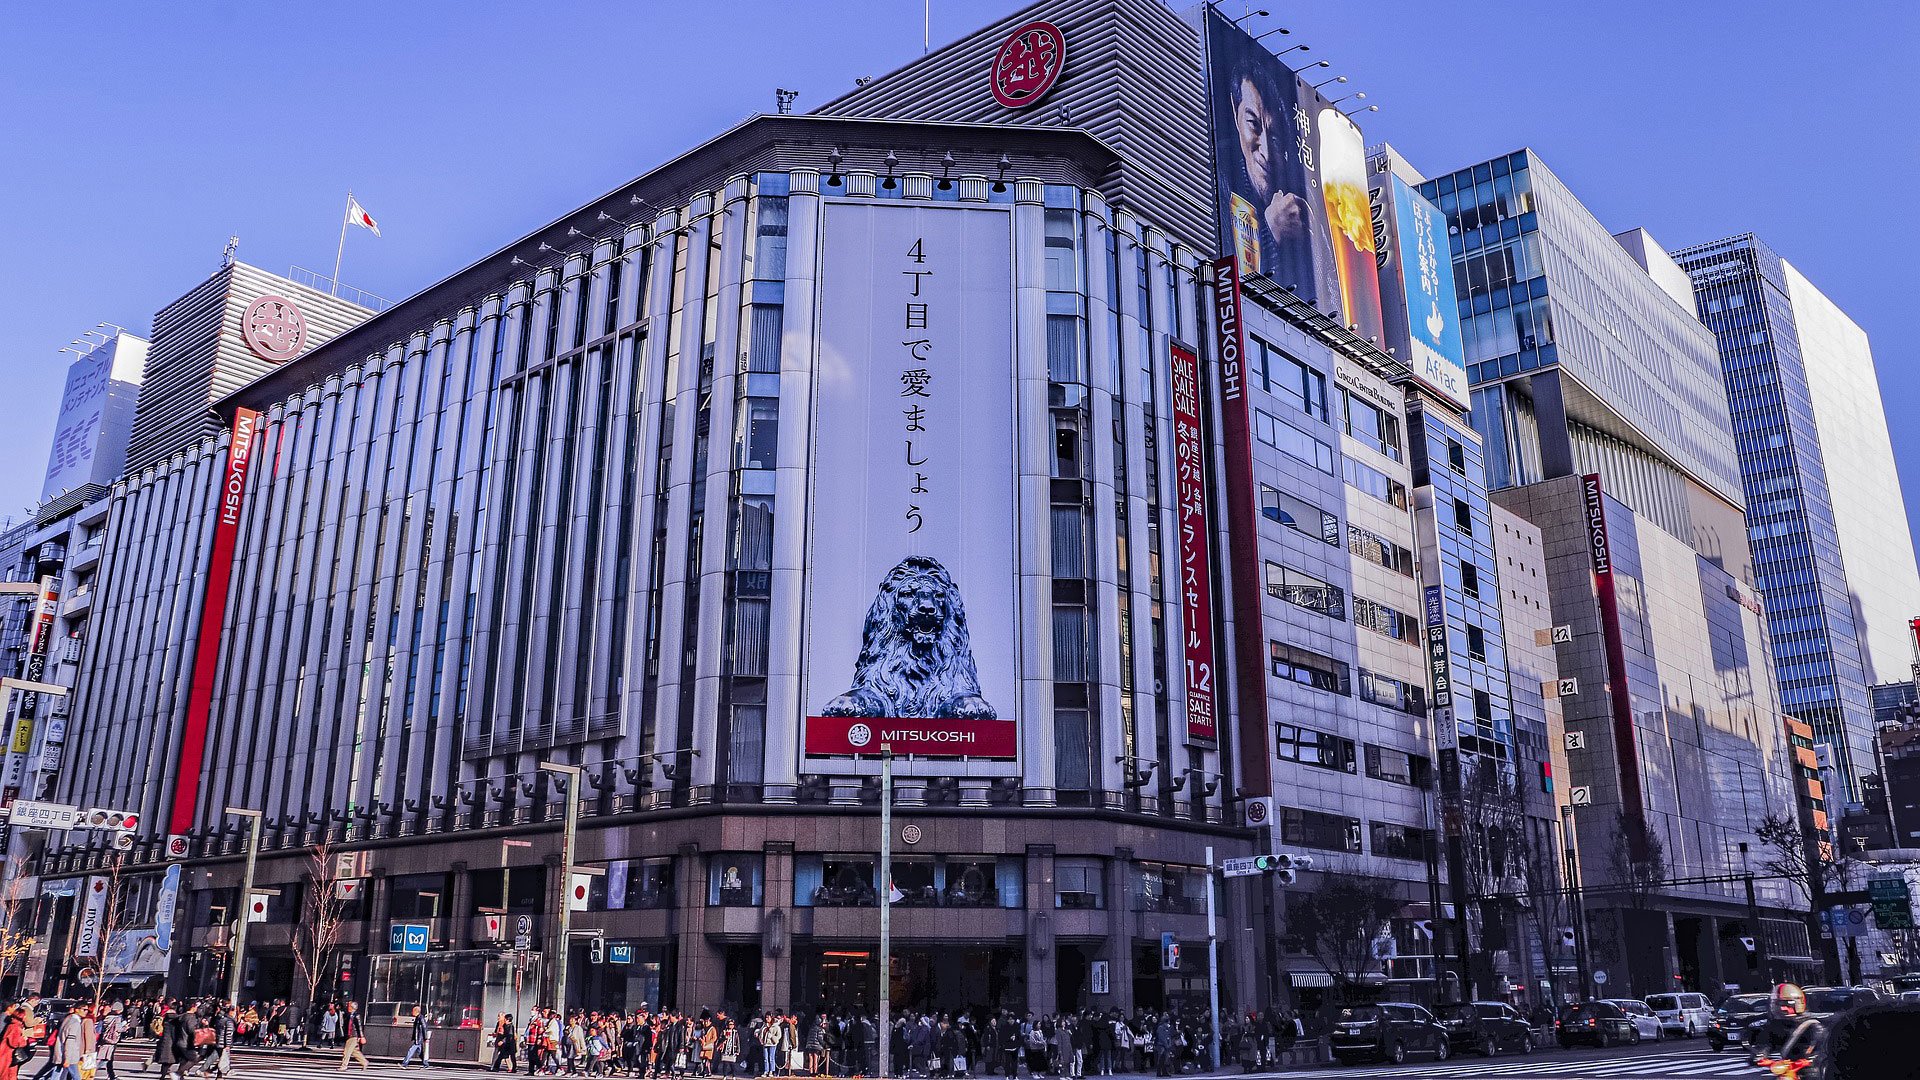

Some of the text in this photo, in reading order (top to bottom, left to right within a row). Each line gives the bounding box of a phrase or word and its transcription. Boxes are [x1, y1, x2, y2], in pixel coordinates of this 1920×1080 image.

[1293, 103, 1317, 188] 神泡。
[1217, 265, 1241, 401] MITSUKOSHI
[1173, 355, 1194, 381] SALE
[1426, 356, 1458, 394] Aflac
[900, 237, 934, 534] 4丁目で愛ましょう
[1174, 374, 1195, 400] SALE
[1175, 392, 1196, 418] SALE
[223, 416, 253, 525] MITSUKOSHI
[1178, 420, 1201, 650] 冬のクリアランスセール
[1586, 480, 1609, 574] MITSUKOSHI
[1187, 659, 1210, 693] 1.2
[1189, 699, 1211, 717] SALE
[1189, 713, 1212, 728] START!
[881, 730, 975, 743] MITSUKOSHI
[17, 807, 72, 821] 銀座四丁目
[31, 817, 48, 825] Ginza
